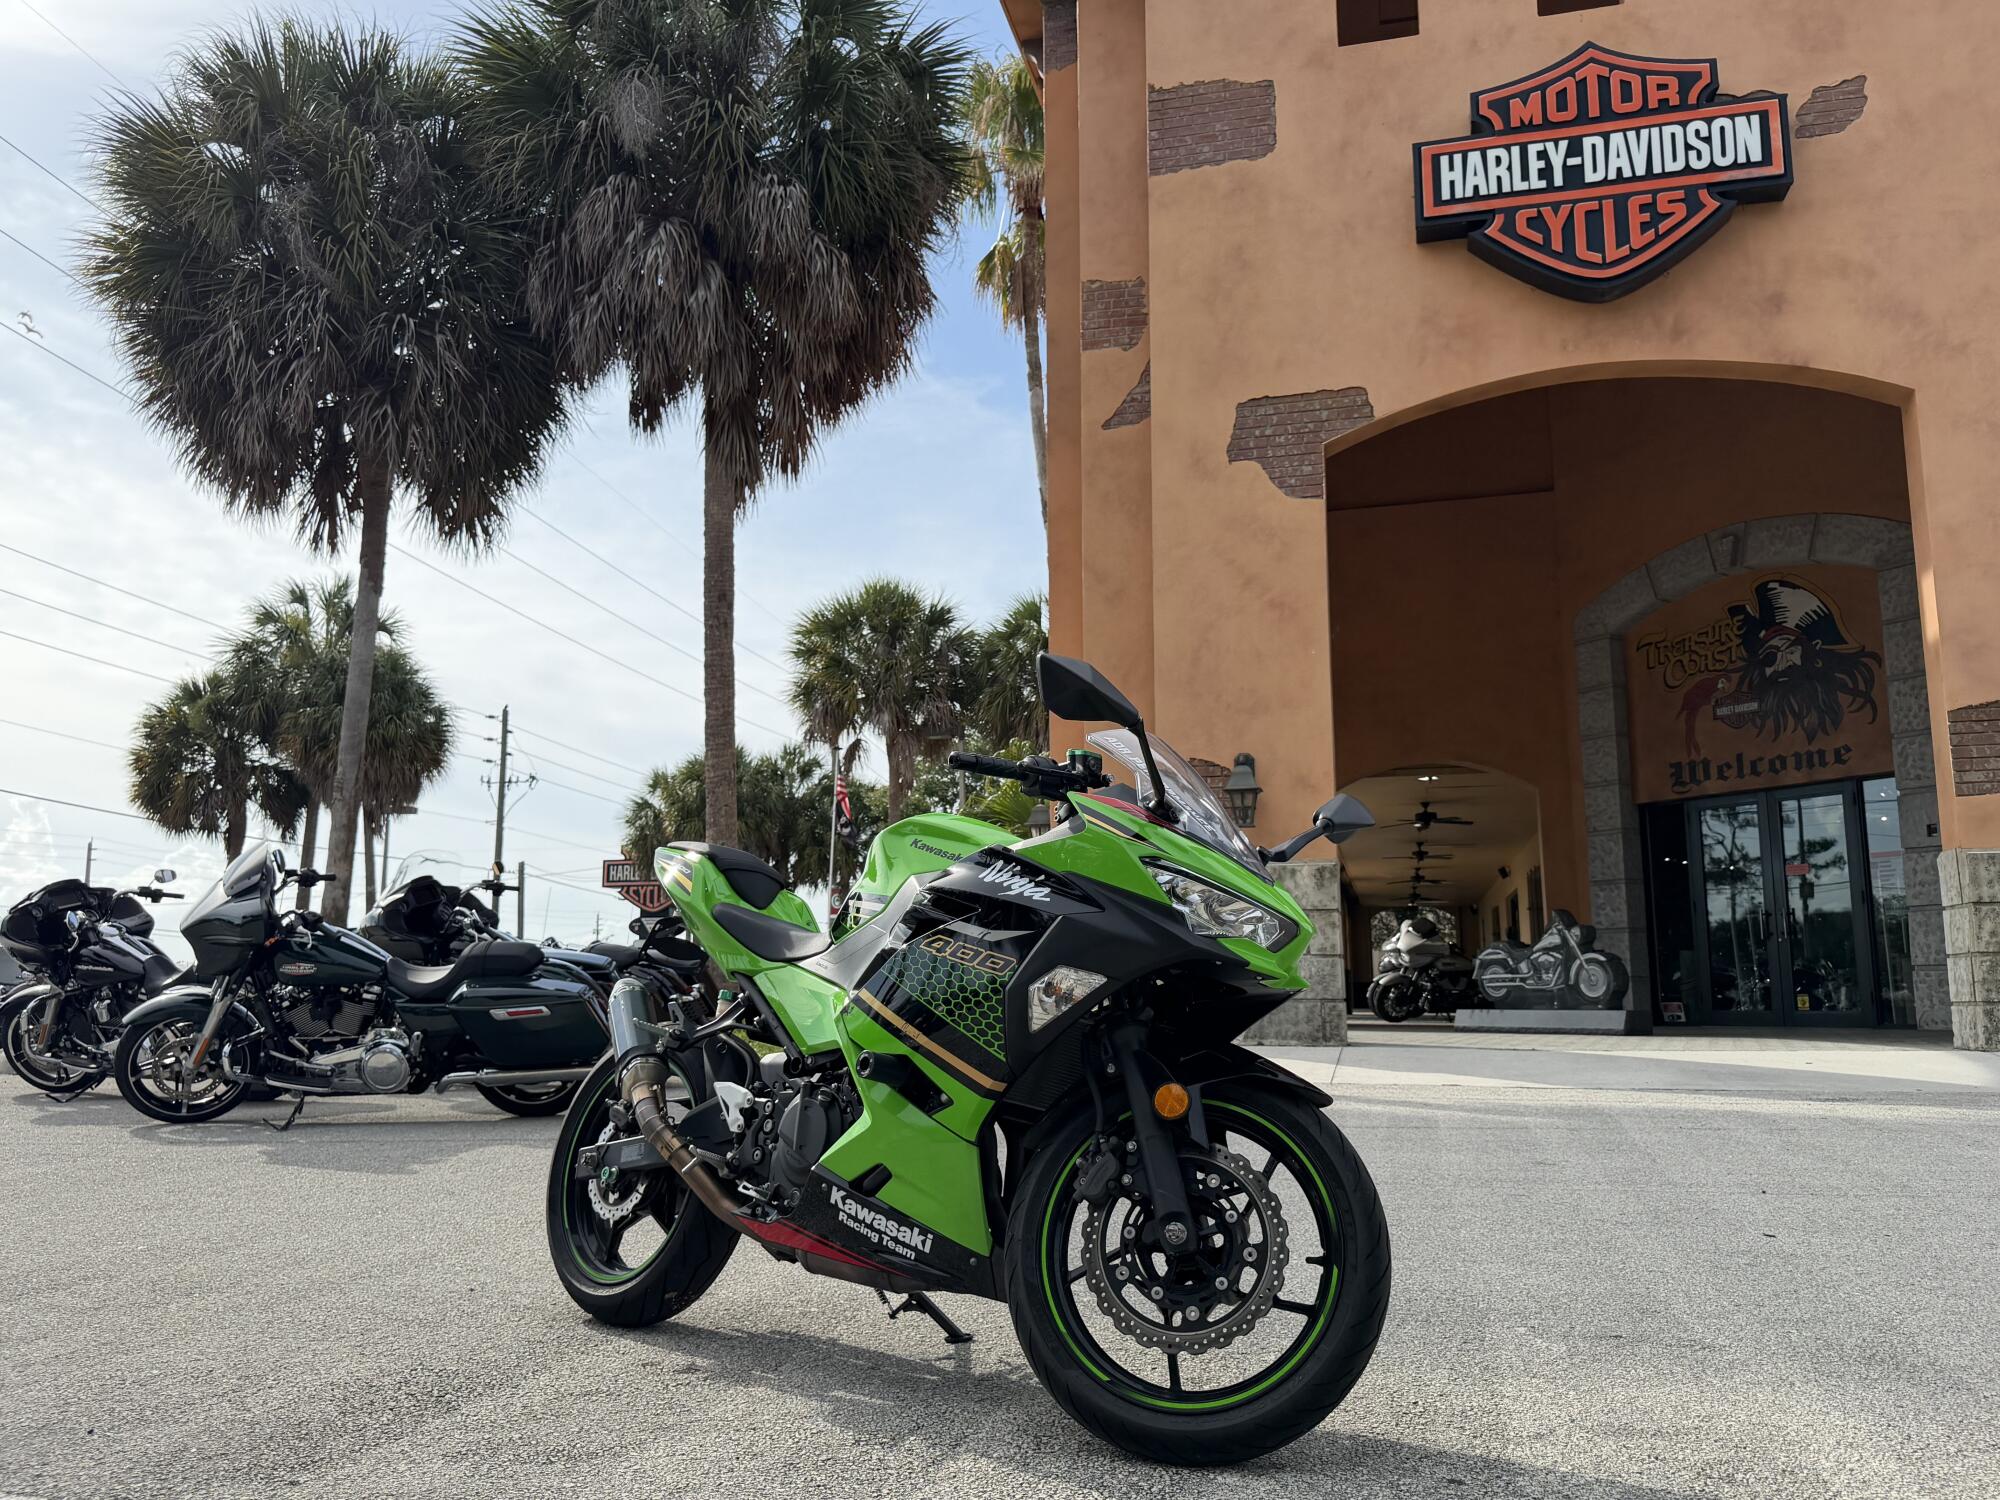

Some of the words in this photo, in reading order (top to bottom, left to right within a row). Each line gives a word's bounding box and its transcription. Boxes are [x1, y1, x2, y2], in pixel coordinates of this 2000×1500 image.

[1509, 62, 1680, 128] MOTOR
[1440, 114, 1763, 200] HARLEY-DAVIDSON
[1515, 190, 1687, 264] CYCLES
[1669, 744, 1853, 794] Welcome
[910, 838, 964, 862] Kawasak
[978, 859, 1051, 902] Ninja
[920, 934, 1017, 975] 400
[830, 1185, 934, 1254] Kawasaki
[838, 1211, 880, 1243] Racing
[881, 1234, 916, 1260] Team
